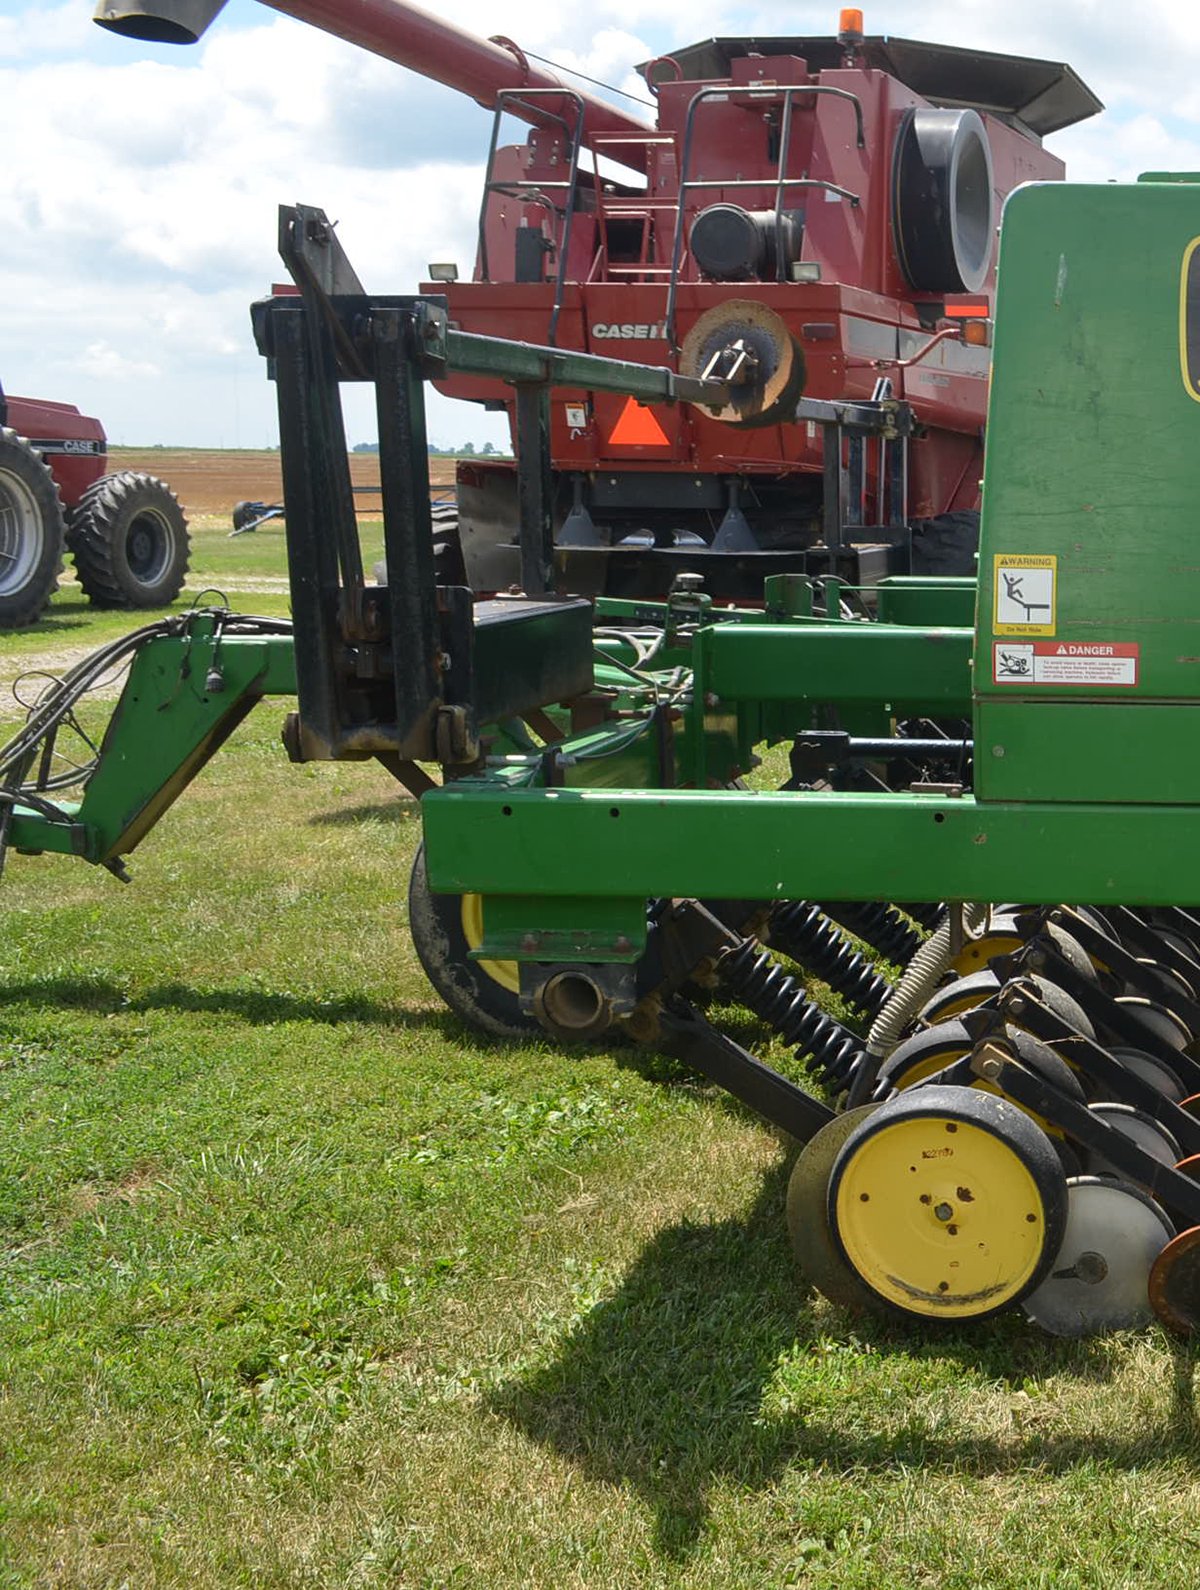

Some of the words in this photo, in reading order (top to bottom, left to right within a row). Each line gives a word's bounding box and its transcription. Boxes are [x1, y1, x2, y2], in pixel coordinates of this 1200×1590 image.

[592, 323, 649, 339] CASE
[64, 441, 94, 453] CASE
[1008, 557, 1052, 566] WARNING
[1069, 646, 1114, 656] DANGER
